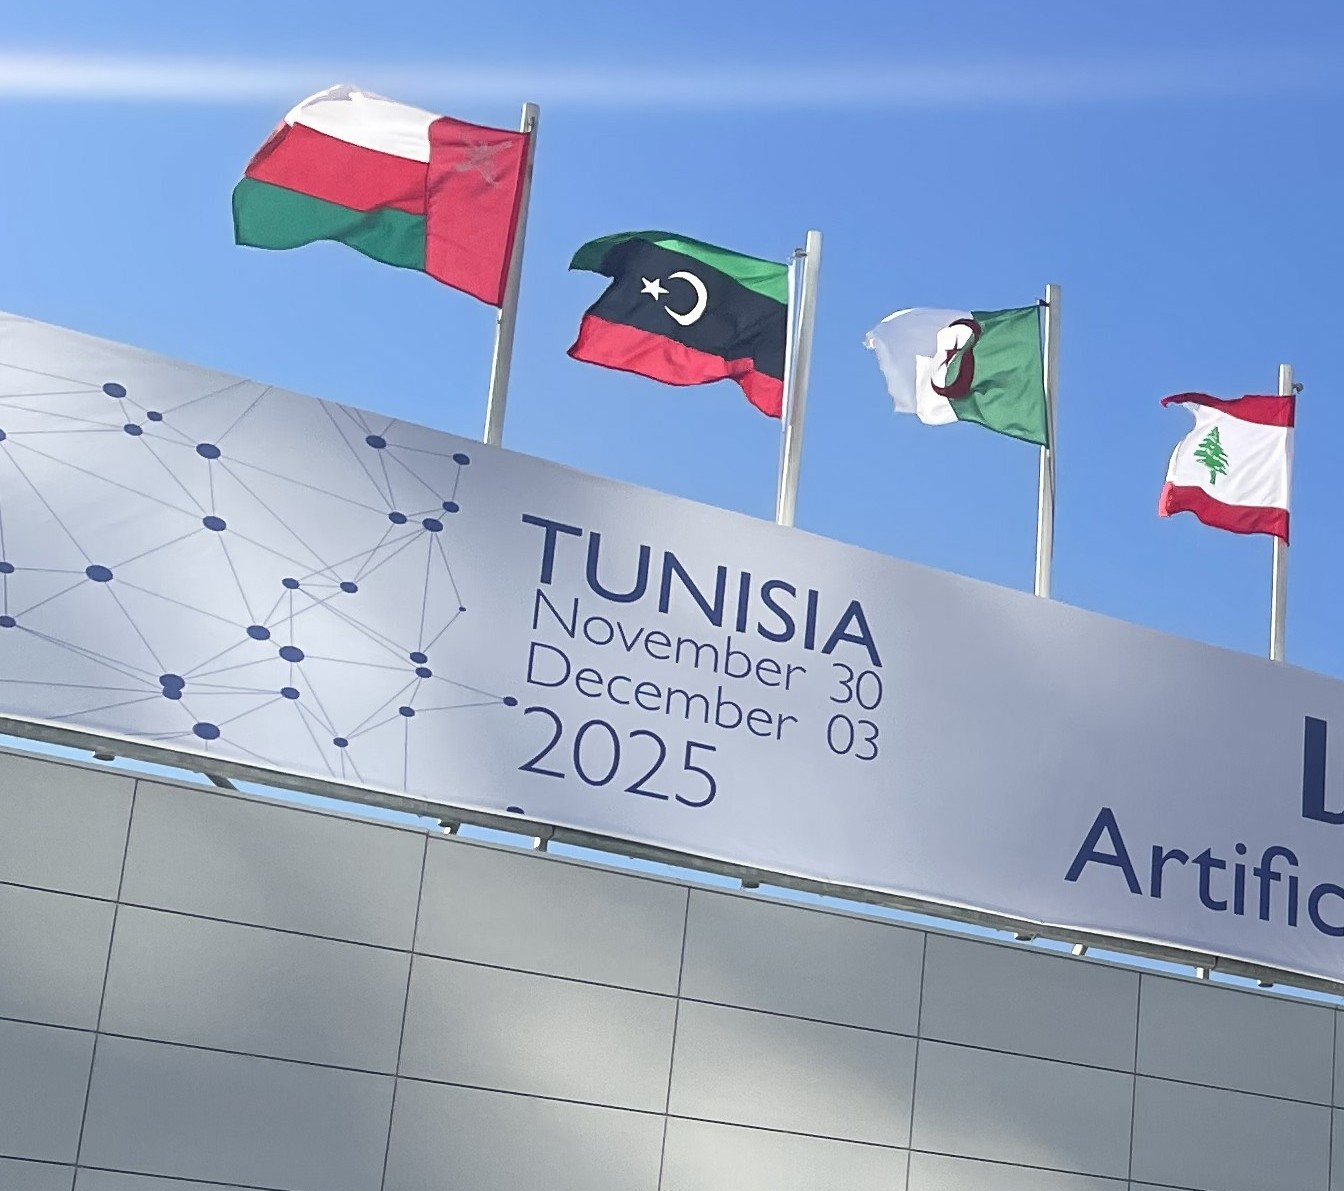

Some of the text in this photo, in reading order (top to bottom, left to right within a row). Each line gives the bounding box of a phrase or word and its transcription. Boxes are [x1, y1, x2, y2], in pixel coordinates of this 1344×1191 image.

[522, 514, 882, 667] TUNISIA
[532, 588, 882, 710] November 30
[518, 706, 717, 807] 2025
[526, 641, 880, 760] December 03
